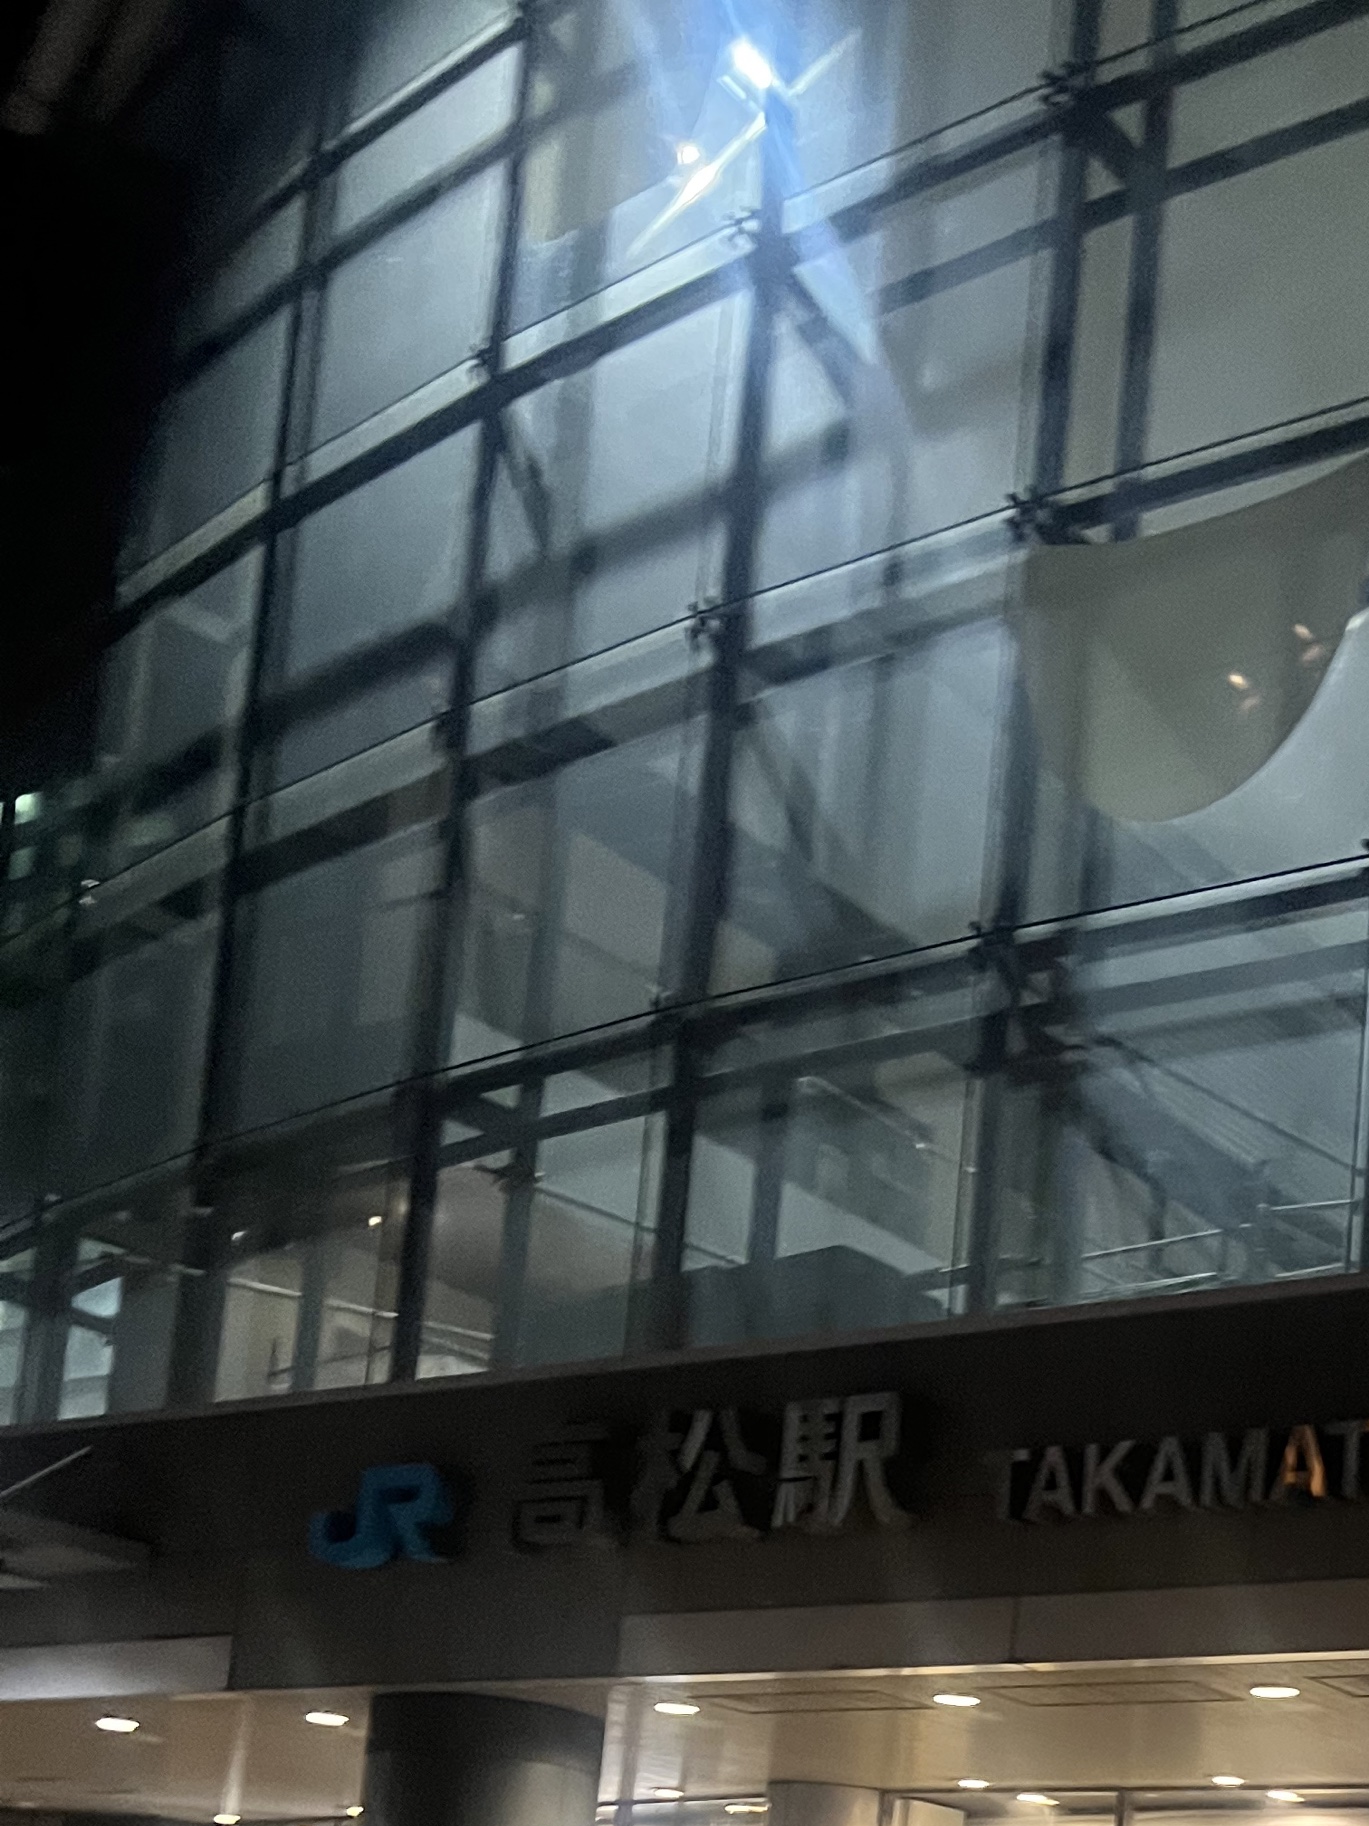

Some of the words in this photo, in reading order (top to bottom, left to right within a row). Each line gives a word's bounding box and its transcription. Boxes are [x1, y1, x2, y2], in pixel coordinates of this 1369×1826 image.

[308, 1463, 456, 1570] JR
[511, 1391, 914, 1549] 高松駅
